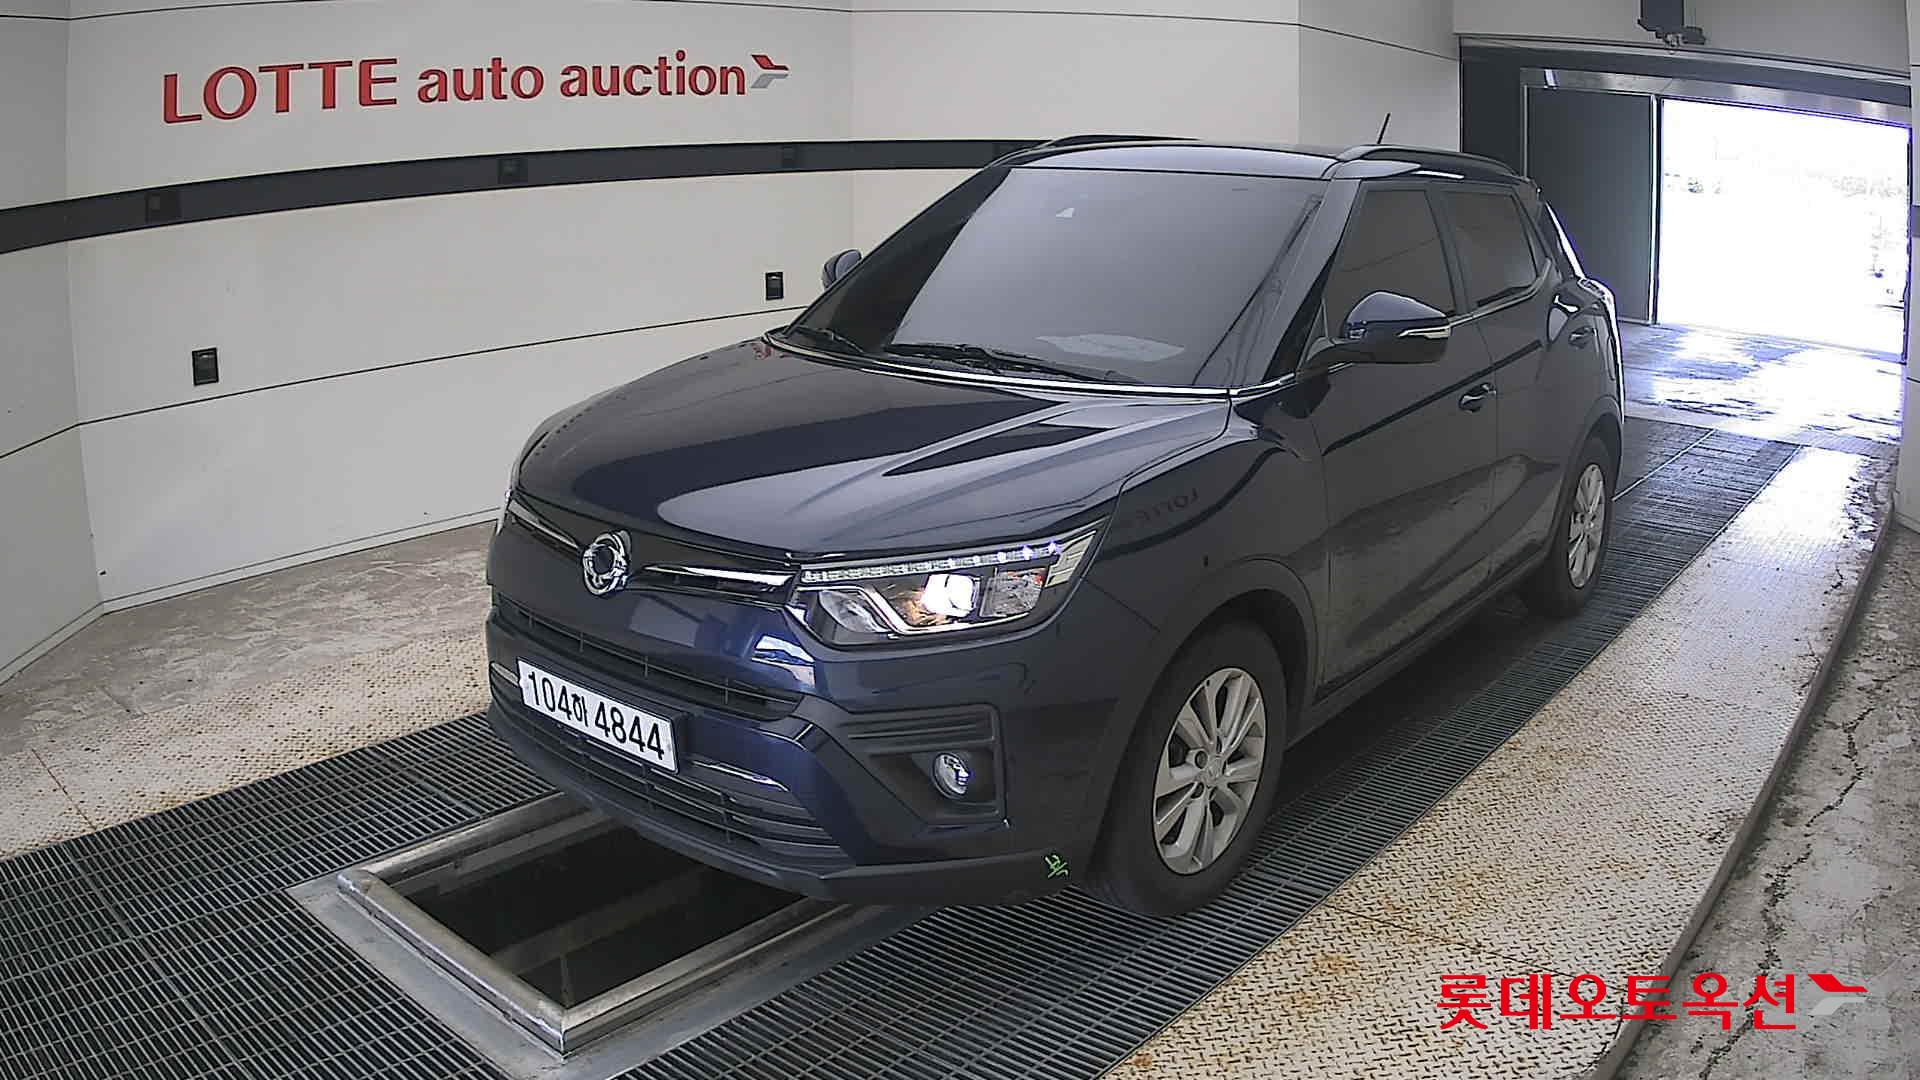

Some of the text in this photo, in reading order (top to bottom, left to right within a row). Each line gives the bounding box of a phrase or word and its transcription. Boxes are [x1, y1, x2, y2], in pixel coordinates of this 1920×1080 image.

[163, 49, 748, 124] LOTTE auto auction
